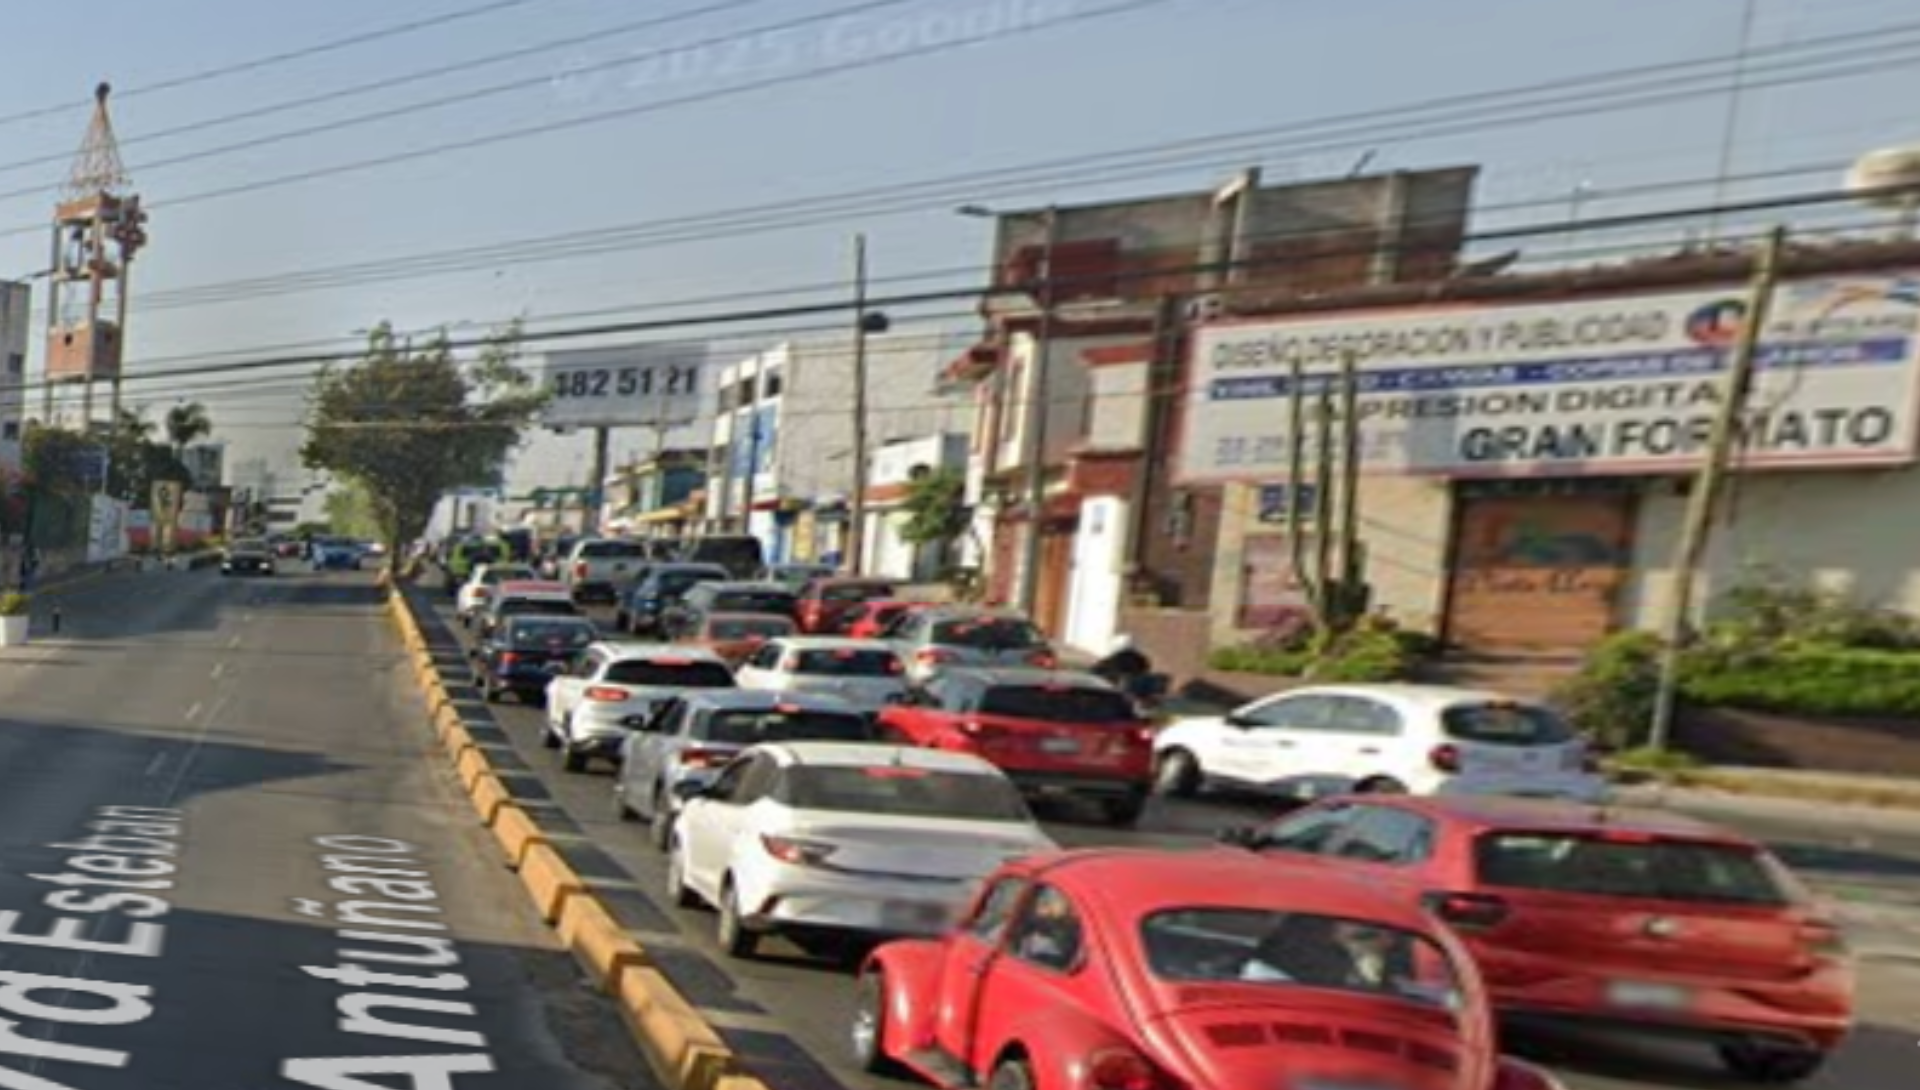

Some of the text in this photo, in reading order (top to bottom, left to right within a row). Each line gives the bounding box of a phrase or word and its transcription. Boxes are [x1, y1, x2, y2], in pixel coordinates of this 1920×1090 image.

[616, 367, 654, 396] 51
[1556, 382, 1725, 412] DIGITA
[1461, 423, 1597, 463] GRAN
